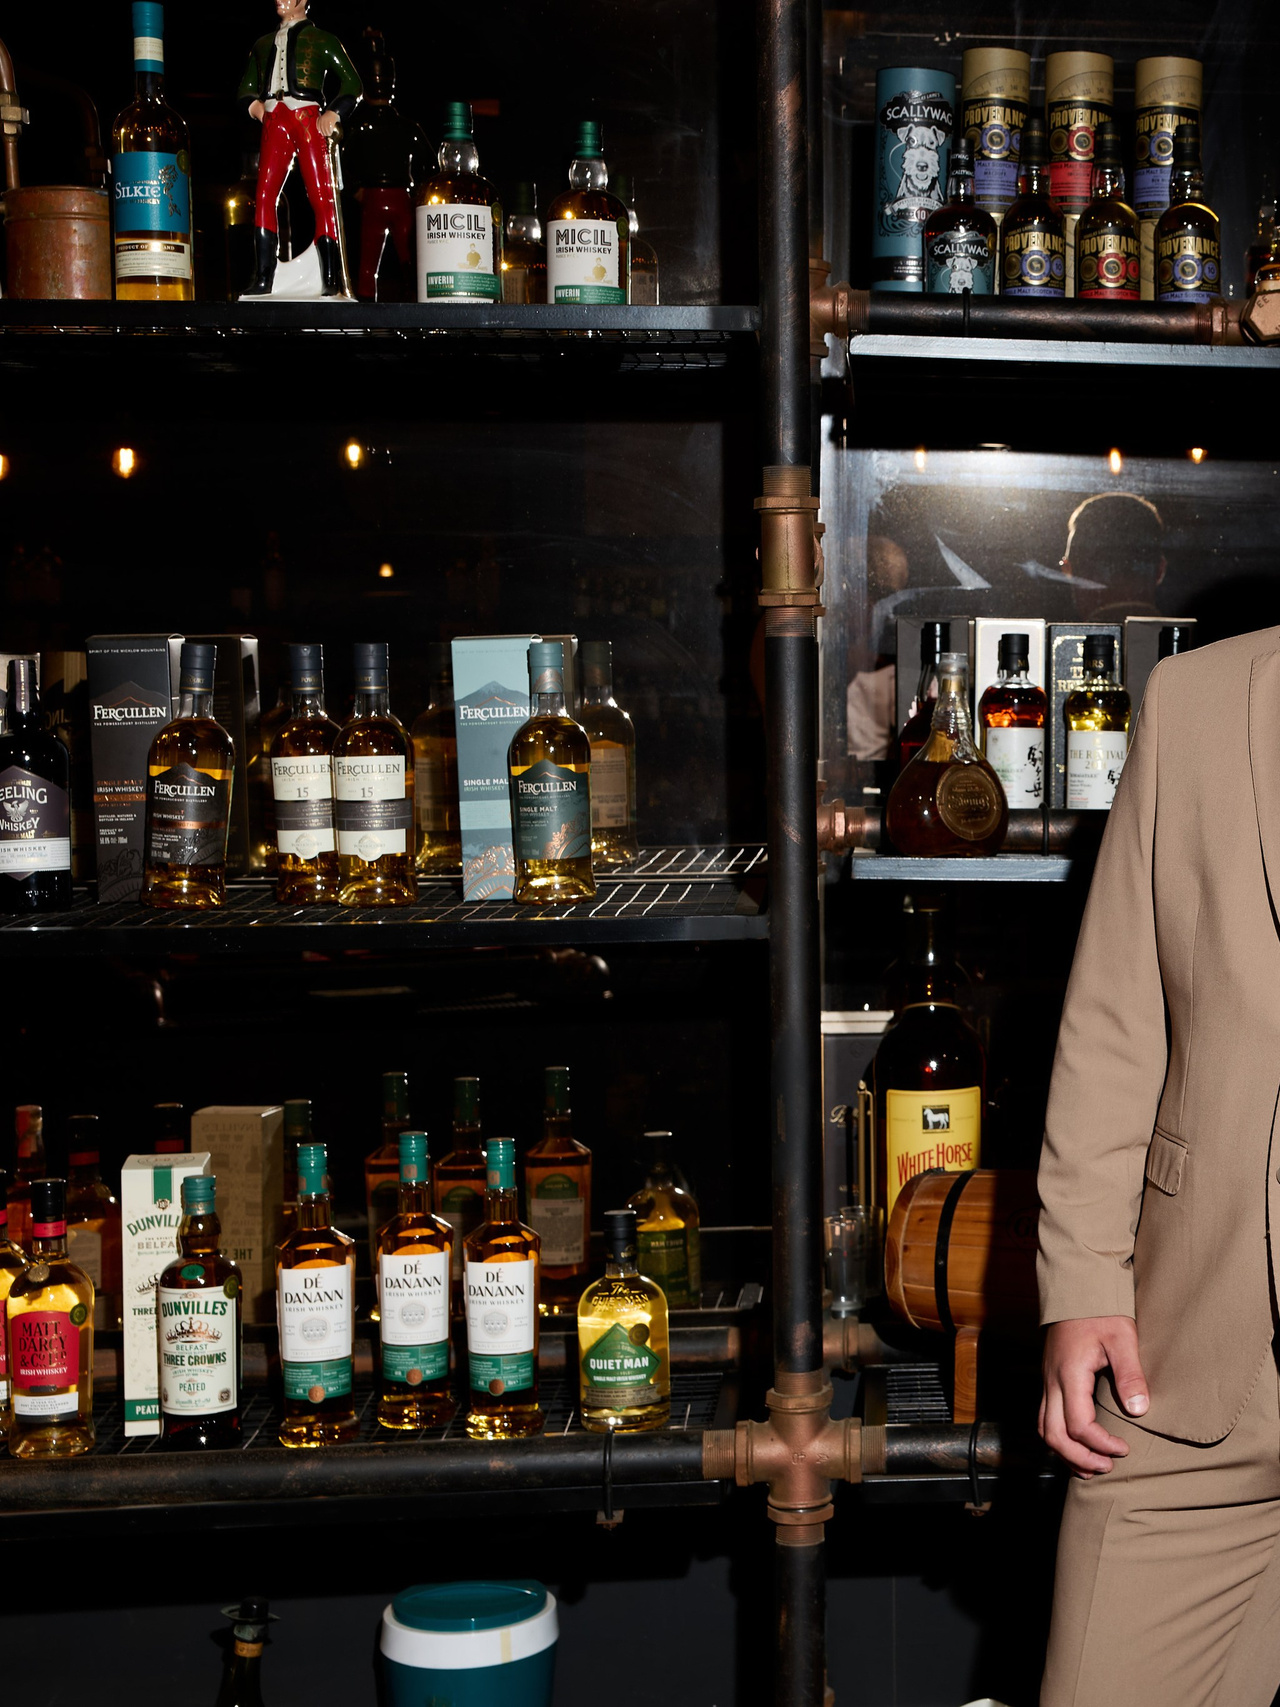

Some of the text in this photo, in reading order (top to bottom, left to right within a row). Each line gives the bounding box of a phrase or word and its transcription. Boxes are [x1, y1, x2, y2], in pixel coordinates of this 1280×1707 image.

[886, 105, 954, 126] SCALLYWAG
[916, 210, 927, 219] 10
[426, 213, 486, 232] MICIL
[426, 232, 486, 240] IRISH WHISKEY
[555, 228, 612, 247] MICIL
[555, 246, 612, 255] IRISH WHISKEY
[933, 243, 989, 257] SCALLYWAG
[1207, 266, 1216, 276] 10
[427, 276, 455, 285] INVERIN
[555, 288, 581, 298] INVERIN
[93, 704, 168, 722] FERCULLEN
[458, 704, 530, 722] FERCULLEN
[273, 762, 333, 777] FERCULLEN
[337, 761, 400, 777] FERCULLEN
[114, 785, 144, 793] WHISKEY
[153, 779, 216, 798] FERCULLEN
[463, 778, 491, 787] SINGLE
[517, 779, 577, 797] FERCULLEN
[296, 787, 309, 798] 15
[360, 786, 374, 798] 15
[519, 805, 558, 814] SINGLE MALT
[13, 845, 47, 853] WHISKEY
[936, 1141, 974, 1170] HORSE
[403, 1260, 422, 1275] DÉ
[303, 1273, 323, 1289] DÉ
[384, 1275, 442, 1290] DANANN
[485, 1268, 505, 1283] DÉ
[284, 1288, 343, 1304] DANANN
[468, 1284, 525, 1298] DANANN
[284, 1303, 343, 1313] IRISH WHISKEY
[490, 1297, 525, 1306] WHISKEY
[175, 1343, 209, 1351] BELFAST
[163, 1351, 227, 1367] THREE CROWNS
[589, 1356, 649, 1371] QUIET MAN
[19, 1366, 68, 1376] IRISH WHISKEY
[178, 1382, 206, 1392] PEATED
